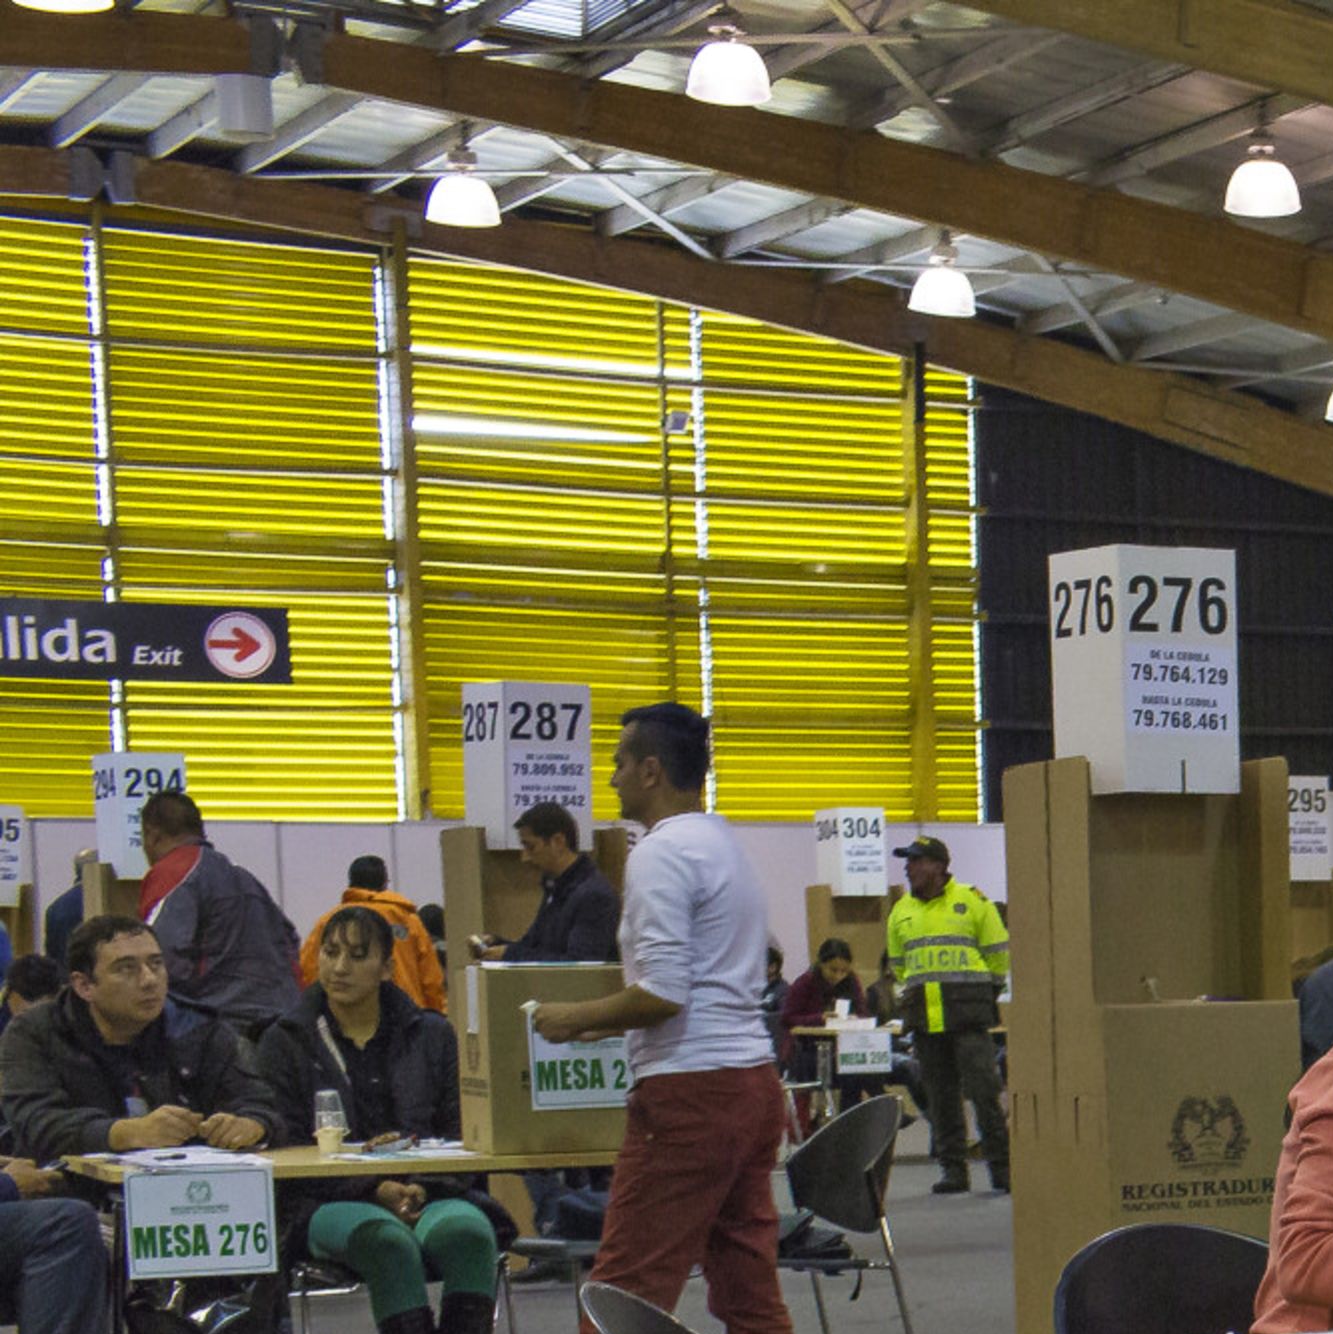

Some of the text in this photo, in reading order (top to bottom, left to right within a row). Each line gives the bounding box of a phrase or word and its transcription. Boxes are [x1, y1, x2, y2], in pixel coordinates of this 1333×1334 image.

[1054, 575, 1115, 639] 276
[1127, 575, 1228, 635] 276
[0, 615, 184, 666] lida Exit
[1131, 663, 1229, 685] 79.764.129
[463, 702, 499, 742] 287
[509, 701, 583, 741] 287
[1132, 709, 1228, 731] 79.768.461
[124, 767, 184, 798] 294
[1289, 788, 1326, 813] 295
[842, 816, 881, 839] 304
[535, 1058, 606, 1091] MESA
[132, 1221, 268, 1259] MESA 276
